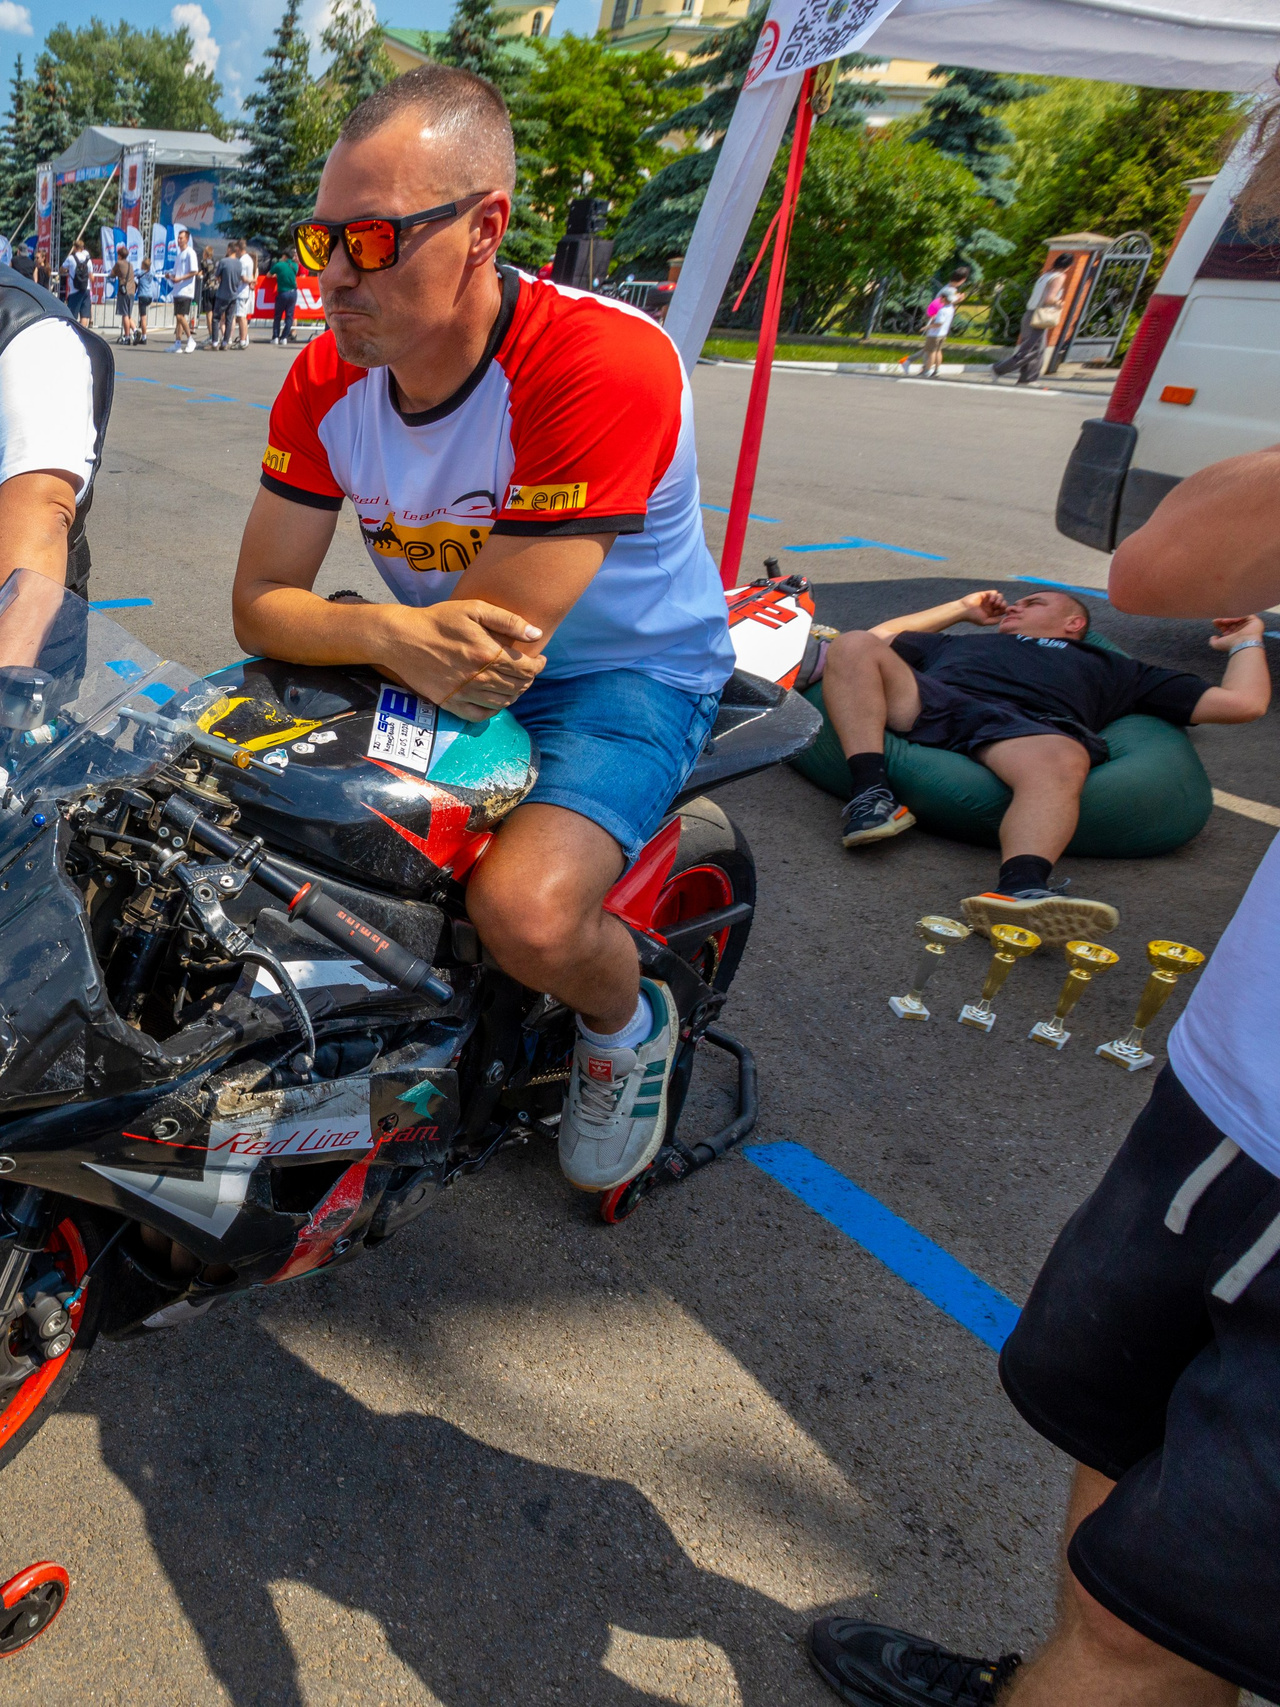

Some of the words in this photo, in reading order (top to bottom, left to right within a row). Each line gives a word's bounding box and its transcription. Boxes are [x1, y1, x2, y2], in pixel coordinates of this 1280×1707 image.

[351, 493, 381, 505] Red
[531, 483, 581, 511] eni
[402, 508, 448, 521] Team
[404, 528, 483, 573] eni
[336, 910, 390, 954] domino
[220, 1131, 300, 1156] Red
[296, 1128, 360, 1153] Line
